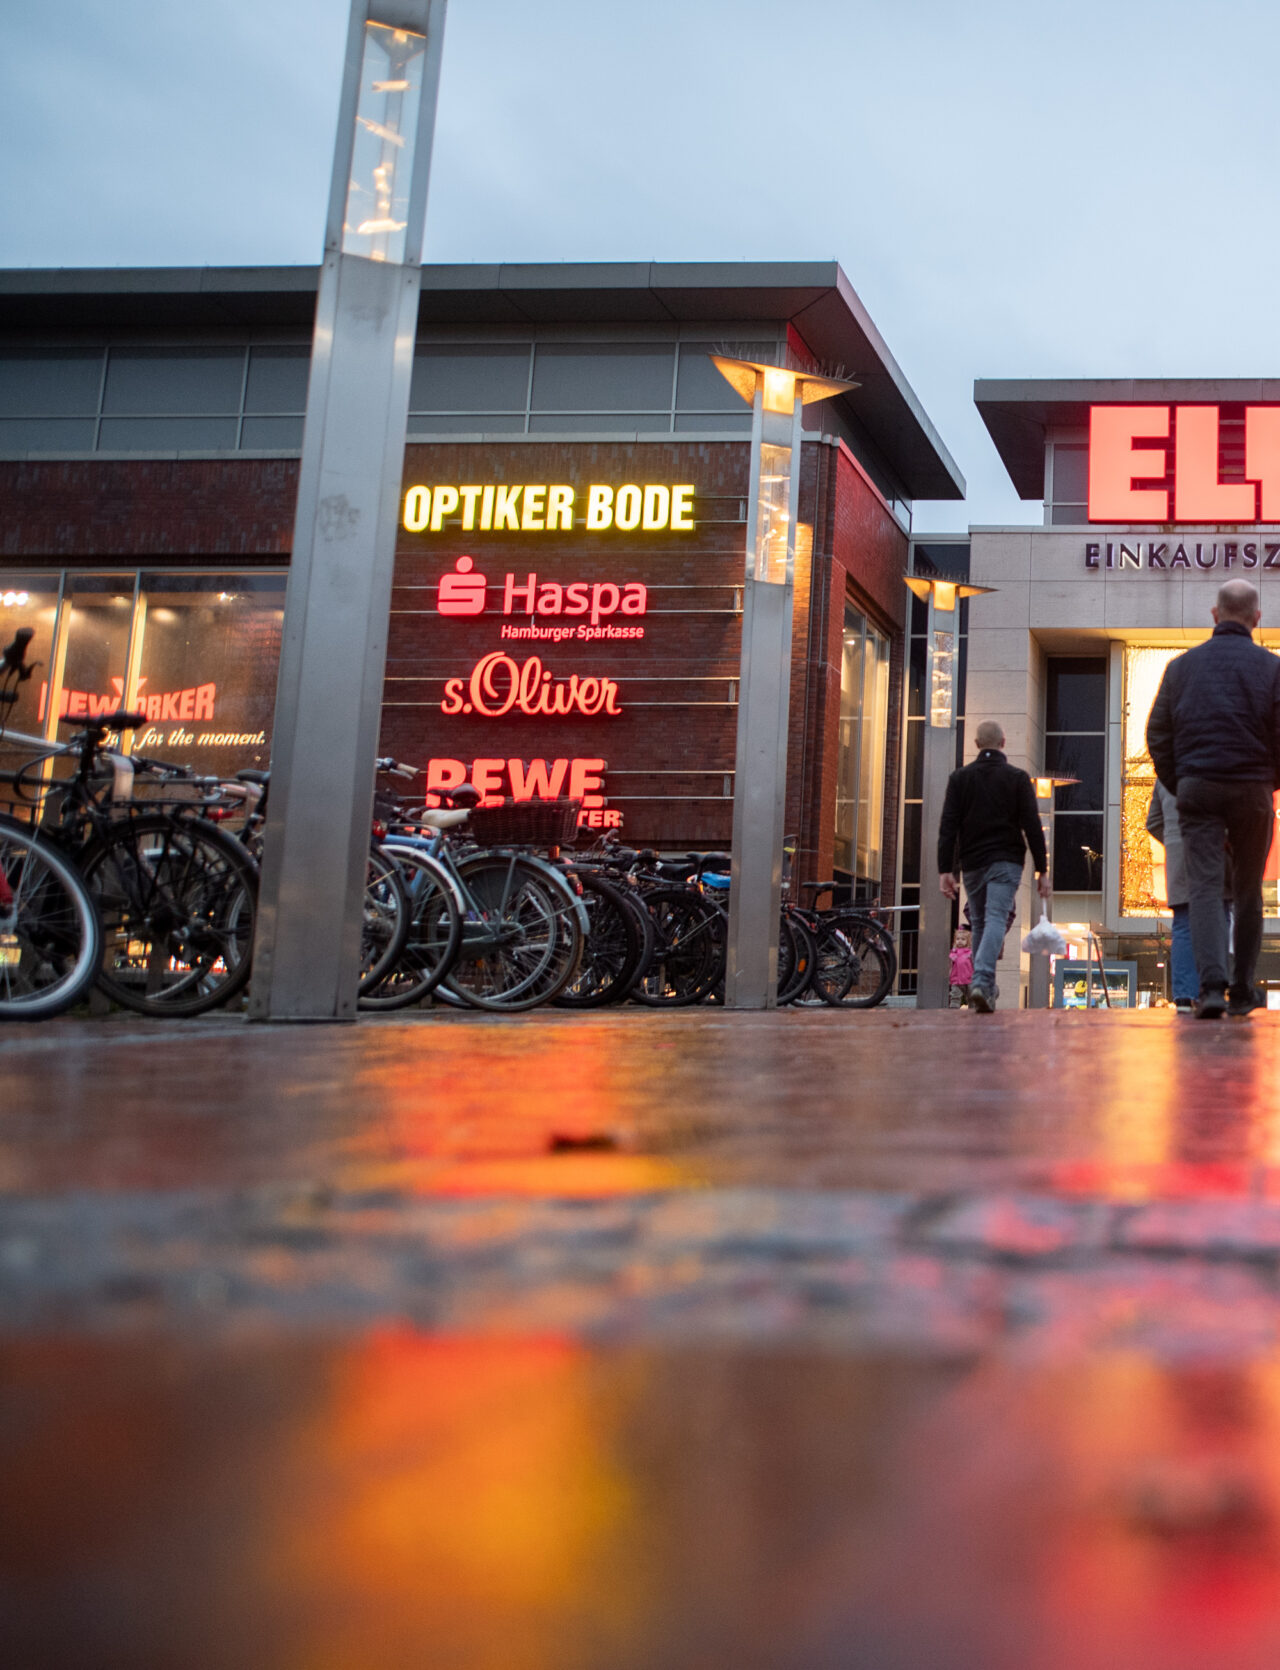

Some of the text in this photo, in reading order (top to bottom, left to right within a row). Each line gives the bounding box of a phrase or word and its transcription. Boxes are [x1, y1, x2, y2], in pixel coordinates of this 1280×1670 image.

[403, 484, 696, 532] OPTIKER BODE
[502, 573, 648, 625] Haspa
[501, 624, 645, 641] Hamburger Sparkasse
[441, 651, 622, 716] s.Oliver
[168, 728, 194, 746] the
[198, 731, 265, 746] moment.
[426, 758, 604, 808] REWE
[576, 810, 621, 828] TER
